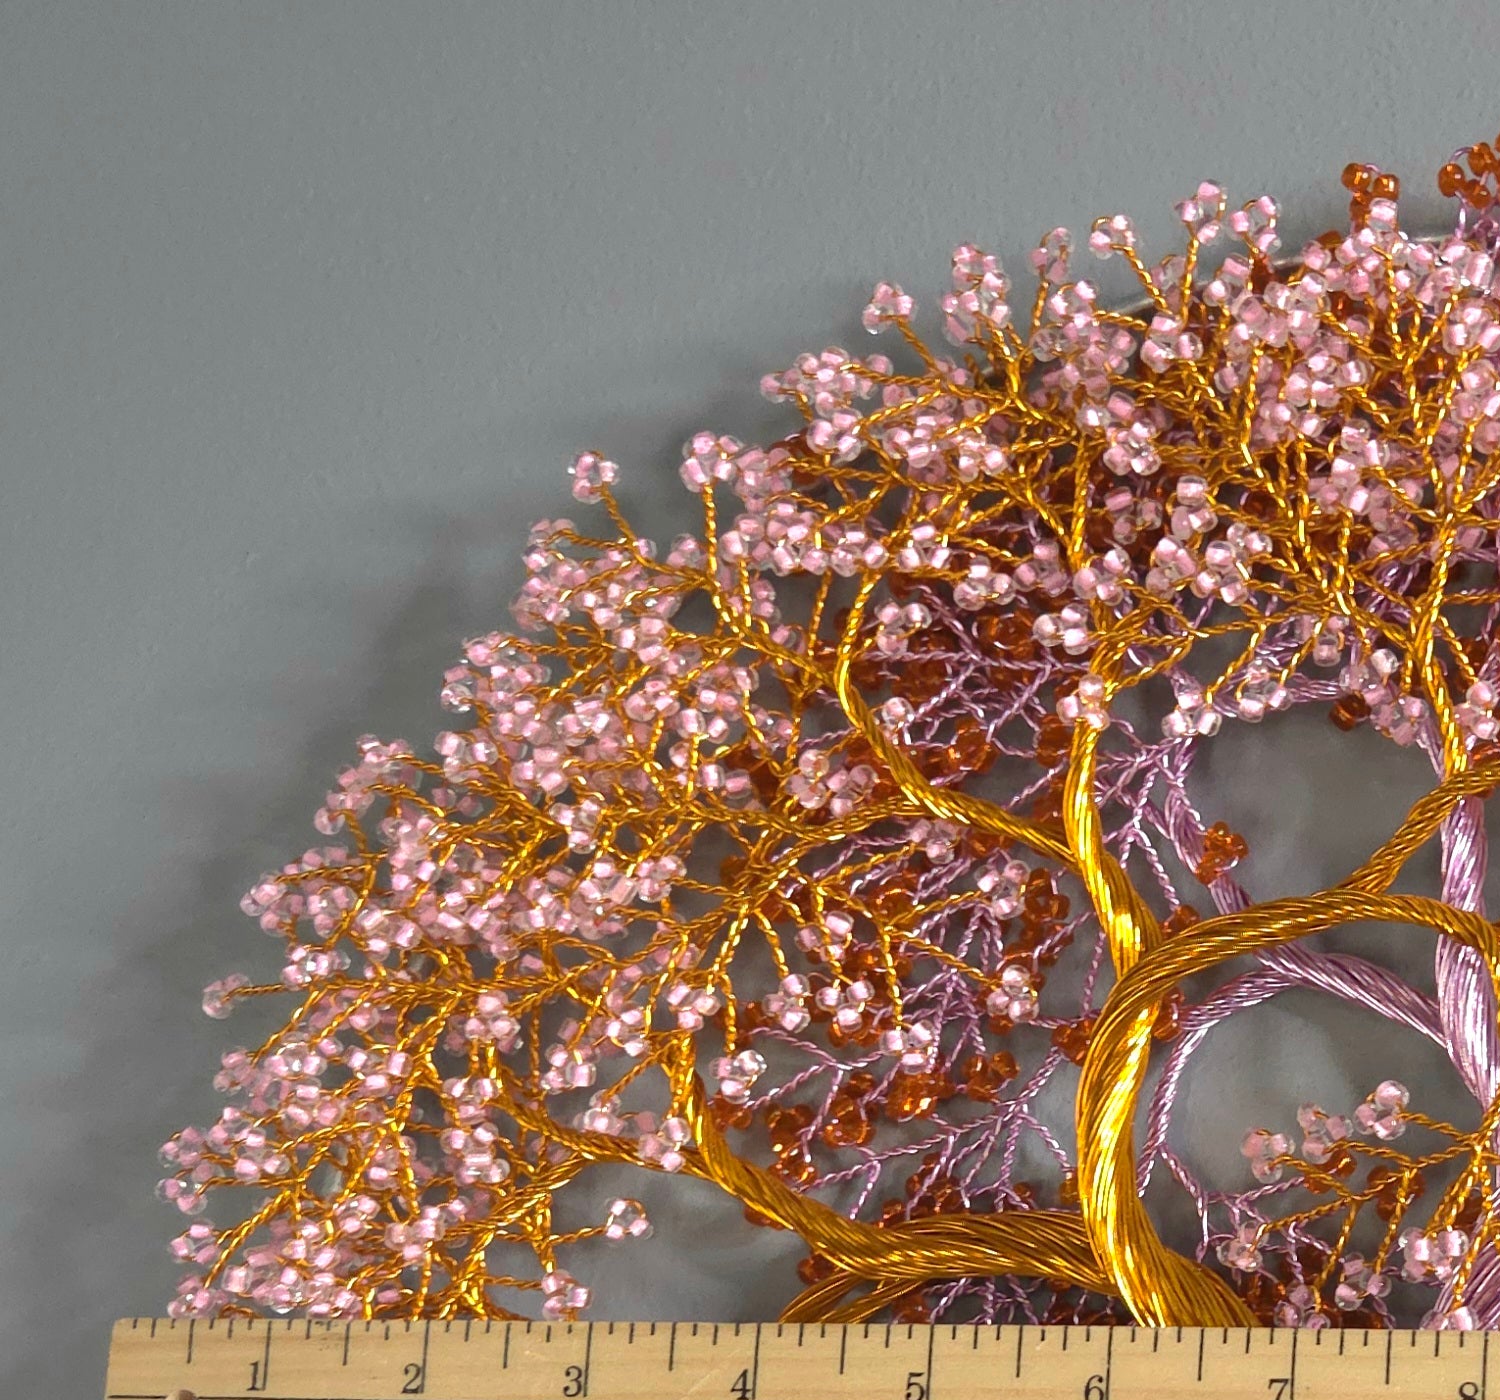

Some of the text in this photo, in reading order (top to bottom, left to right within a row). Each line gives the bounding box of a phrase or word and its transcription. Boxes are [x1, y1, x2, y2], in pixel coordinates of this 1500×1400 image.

[248, 1363, 262, 1391] 1
[402, 1365, 422, 1394] 2
[563, 1367, 584, 1396] 3
[730, 1370, 753, 1399] 4
